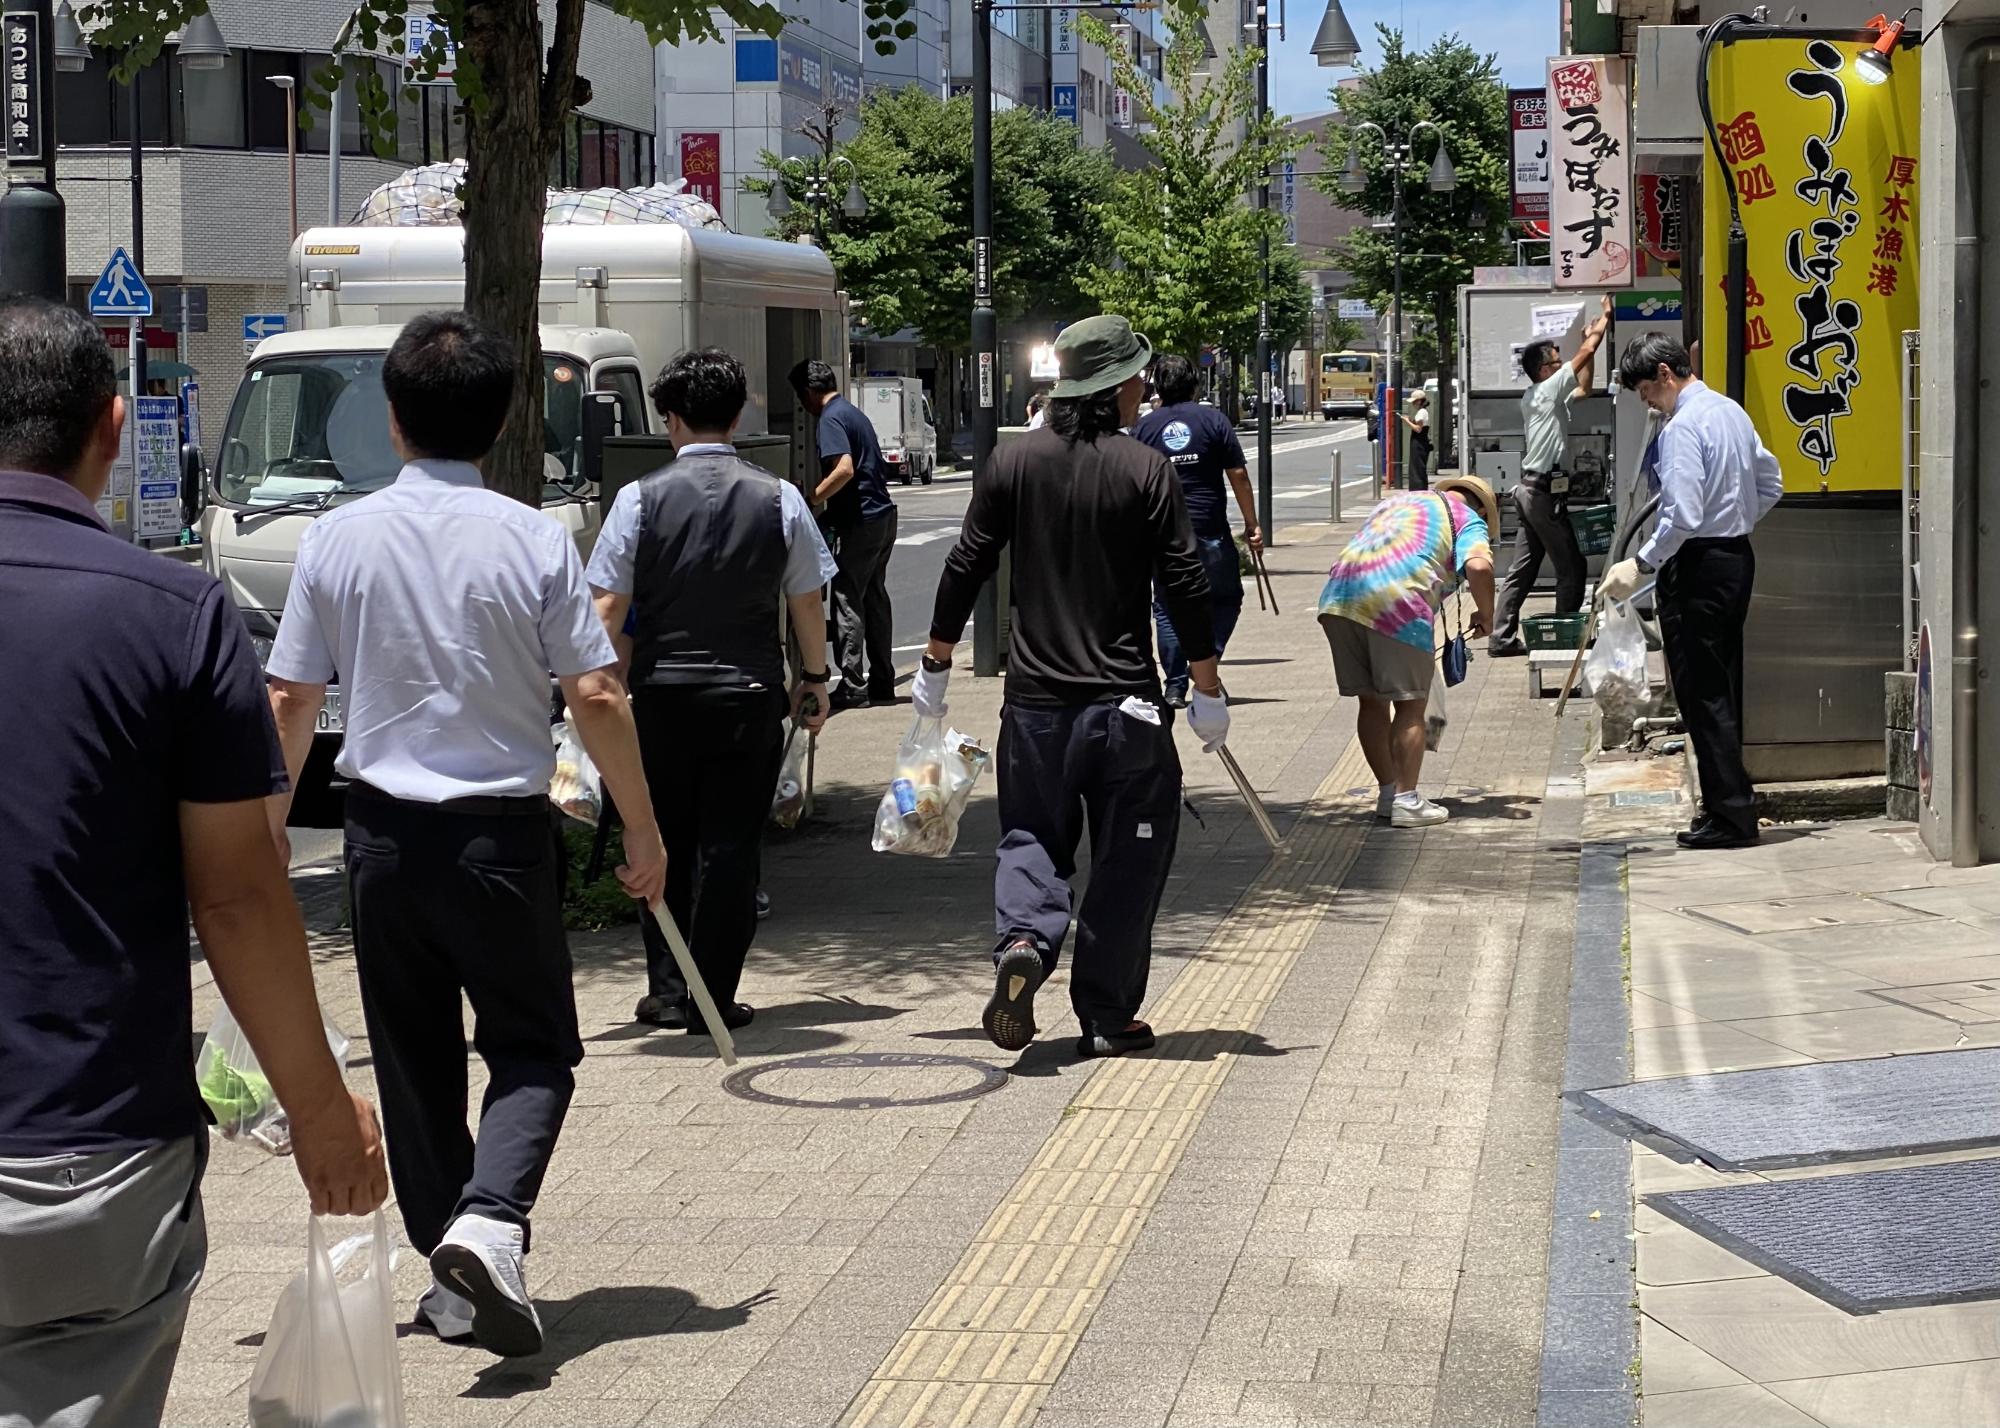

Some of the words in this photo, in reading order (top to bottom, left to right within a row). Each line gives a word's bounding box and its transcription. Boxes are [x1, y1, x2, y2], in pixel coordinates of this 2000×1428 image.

[11, 27, 29, 138] あつぎ商和会
[1520, 113, 1547, 126] 焼き
[1562, 104, 1620, 259] うみぼおず
[1717, 110, 1777, 206] 酒処
[1560, 250, 1574, 279] です
[1783, 39, 1862, 475] うみぼおず
[1866, 153, 1919, 297] 厚木漁港
[1664, 298, 1682, 313] 伊
